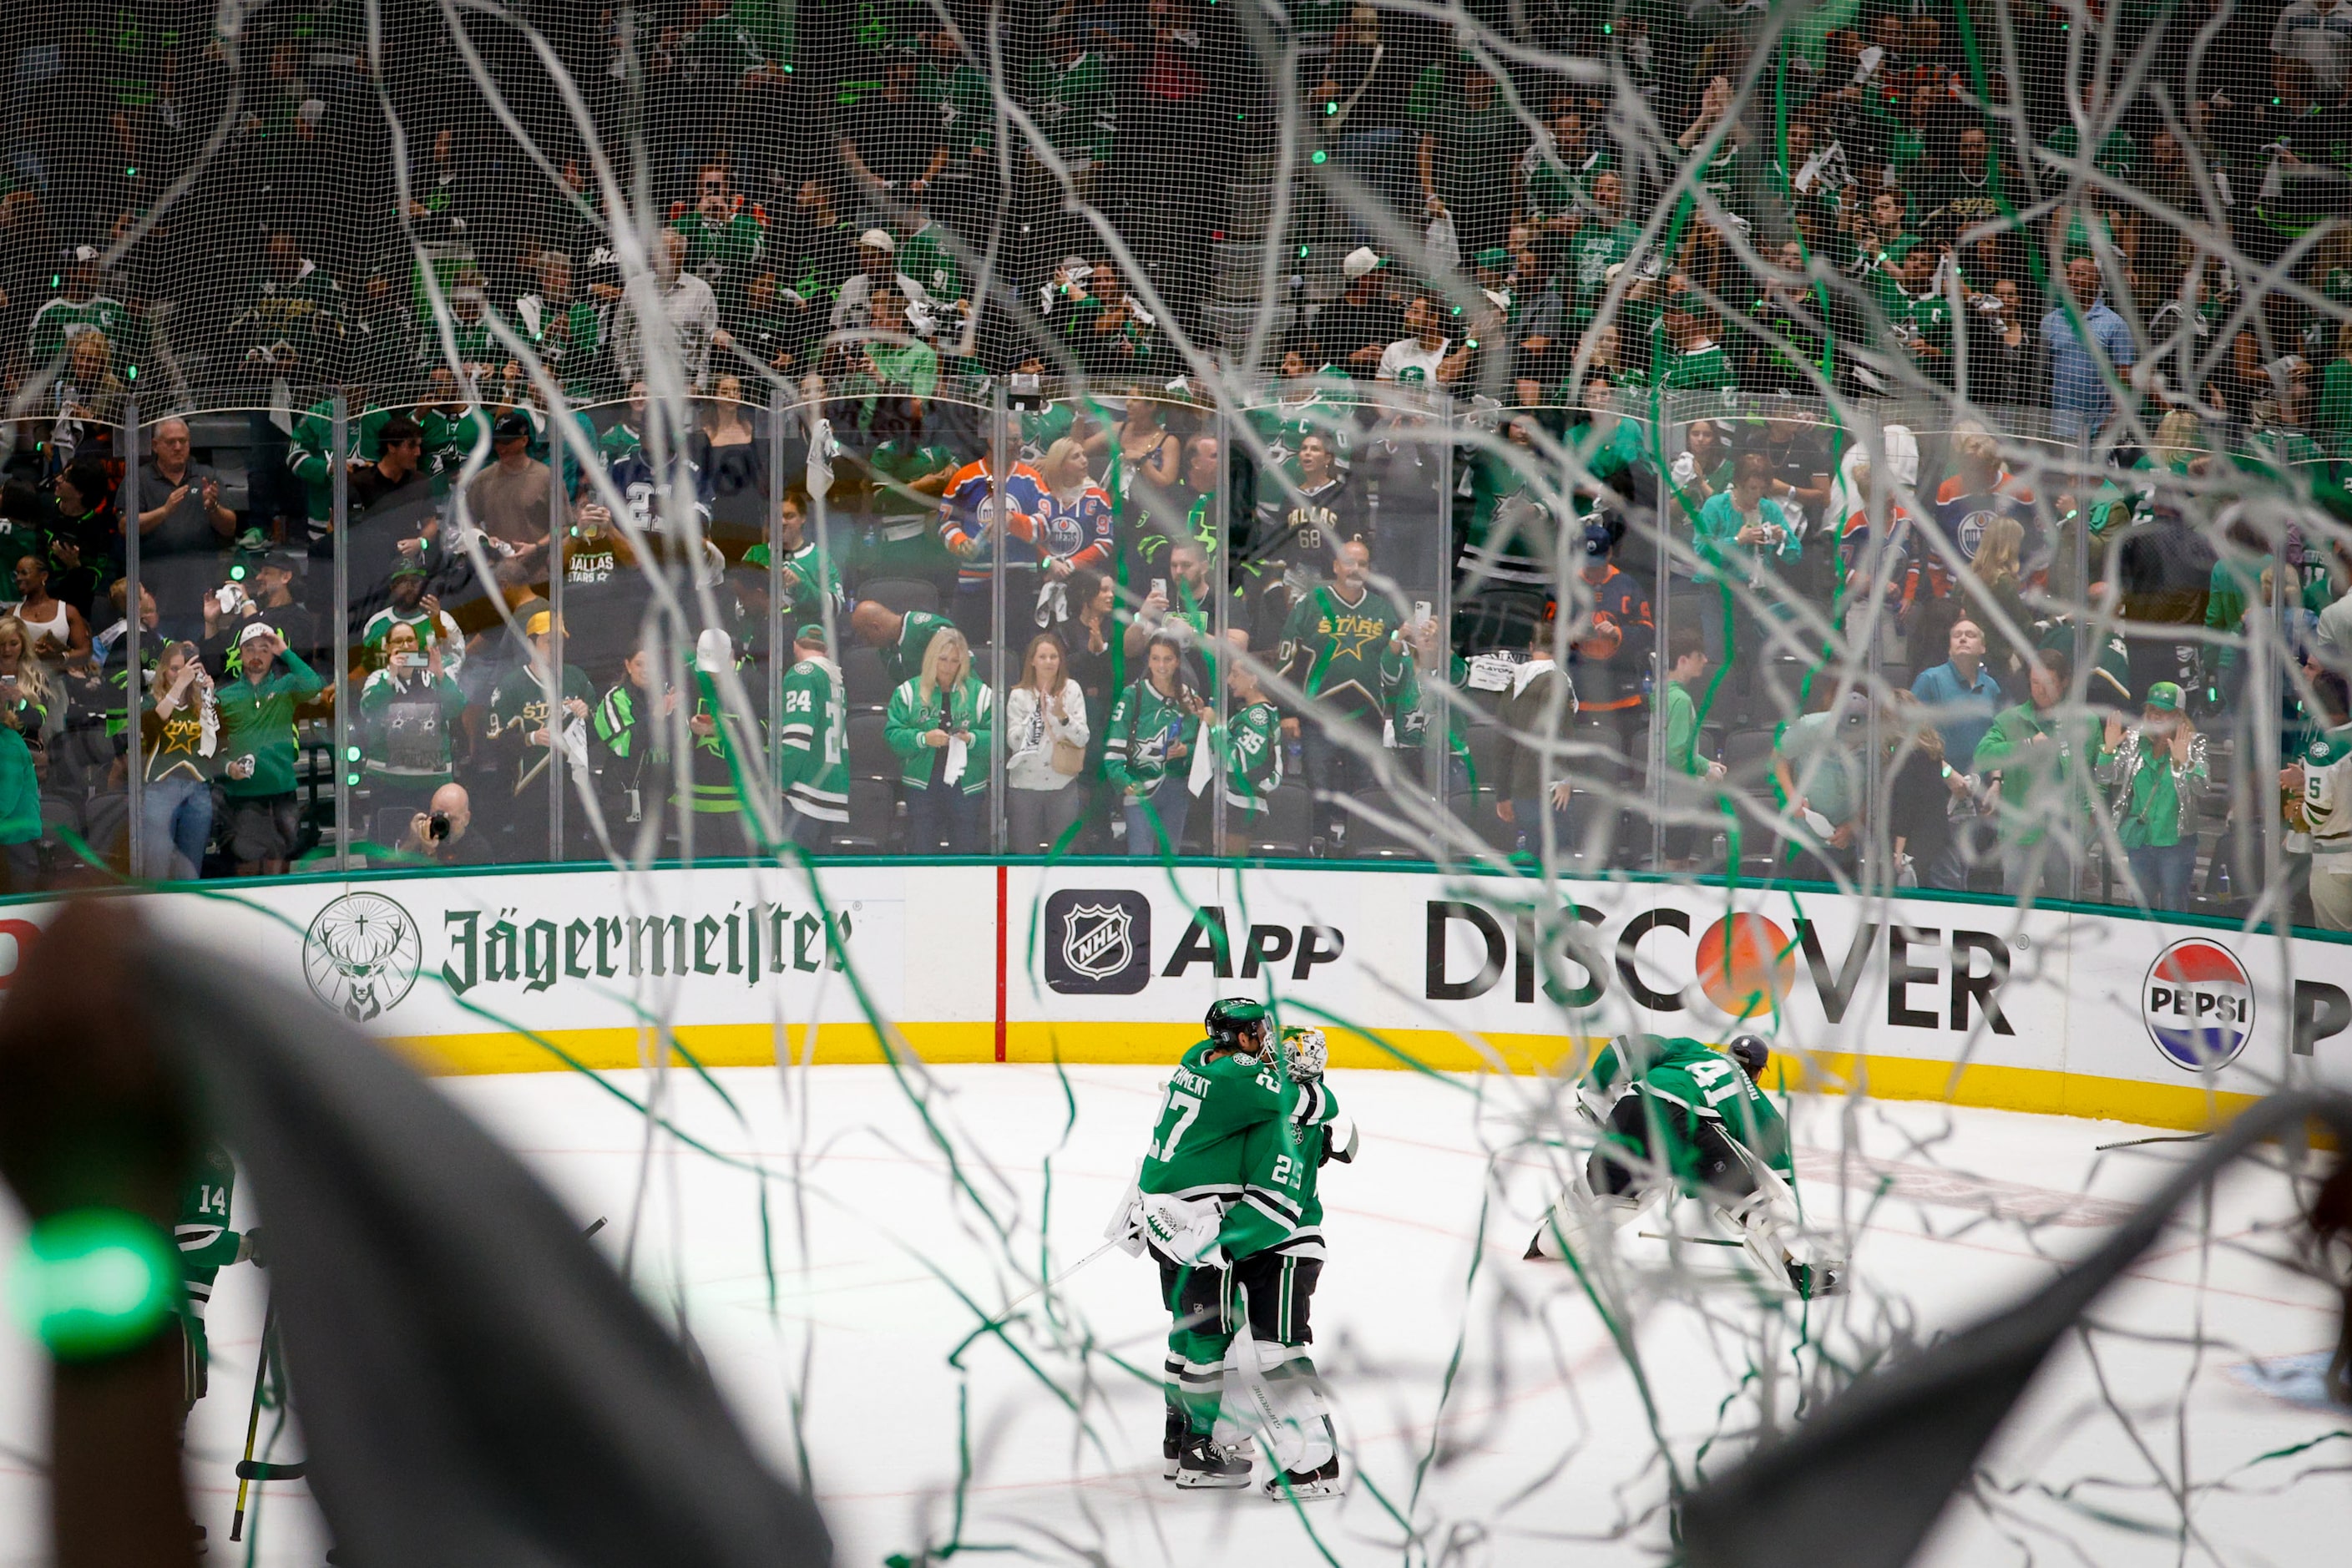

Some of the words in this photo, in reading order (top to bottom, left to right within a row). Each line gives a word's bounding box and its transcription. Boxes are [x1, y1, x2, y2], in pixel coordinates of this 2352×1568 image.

[1297, 529, 1322, 549] 68
[569, 554, 615, 572] DALLAS
[1318, 616, 1386, 636] STARS
[786, 689, 812, 713] 24
[1237, 726, 1267, 756] 35
[2309, 776, 2321, 800] 5
[1078, 922, 1121, 963] NHL
[1424, 898, 2016, 1037] DISCOVER
[2150, 986, 2247, 1024] PEPSI
[1684, 1058, 1745, 1108] 41
[198, 1184, 226, 1216] 14
